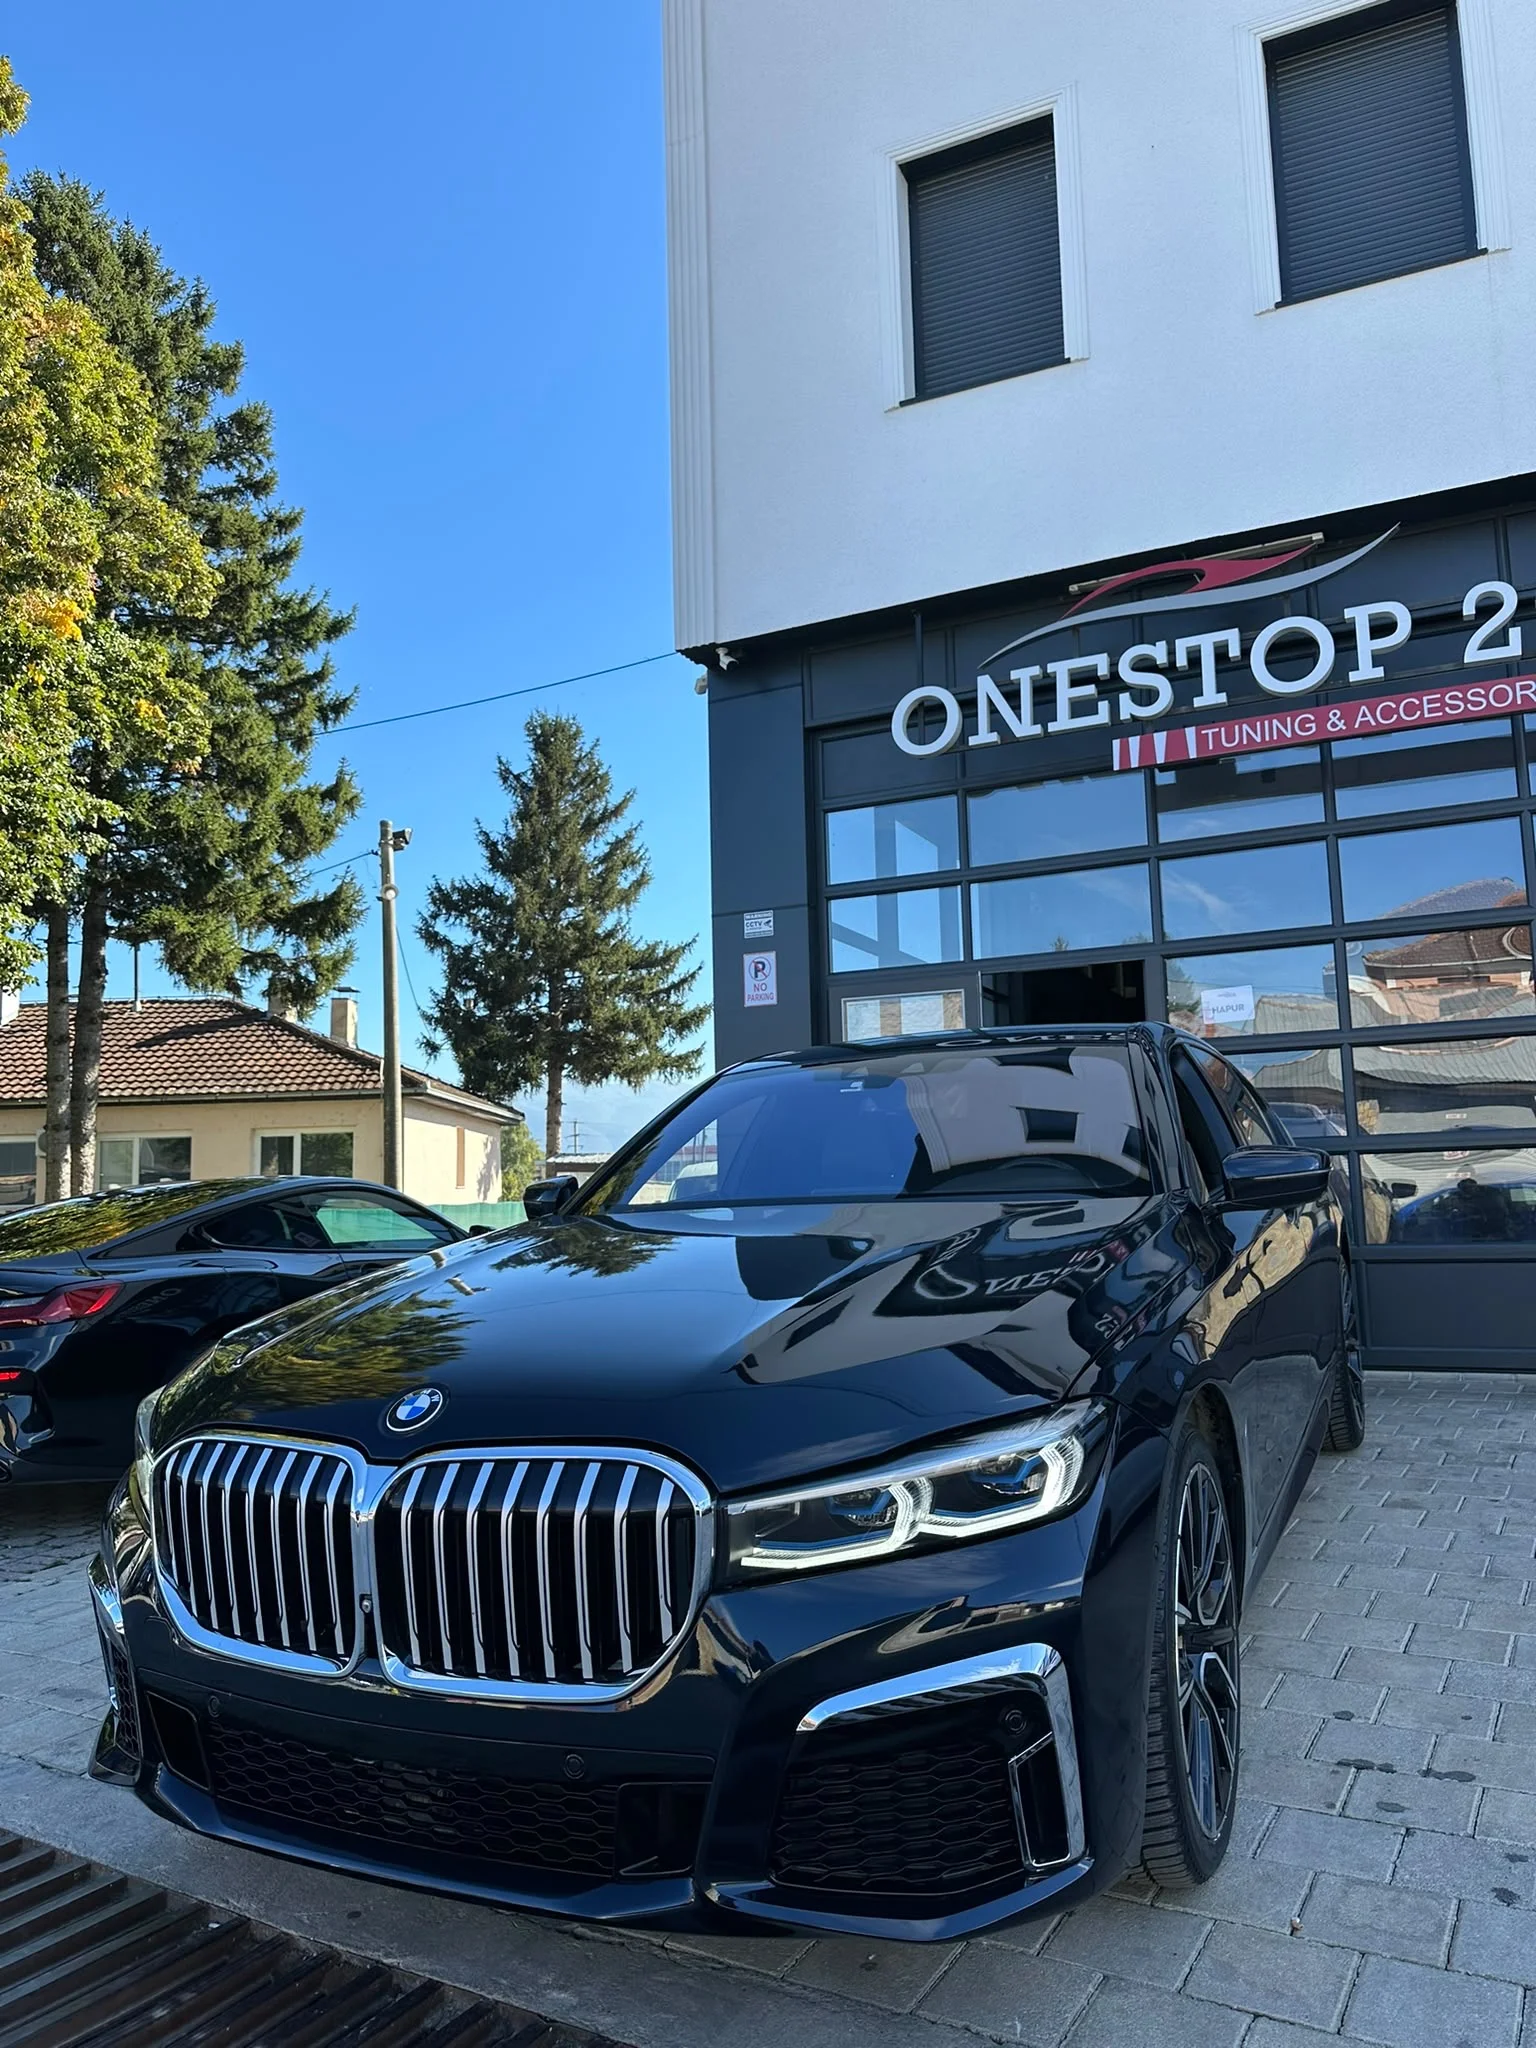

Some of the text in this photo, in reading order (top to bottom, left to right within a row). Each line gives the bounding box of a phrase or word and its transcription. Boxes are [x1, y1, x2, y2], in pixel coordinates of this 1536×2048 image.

[891, 601, 1412, 757] ONESTOP
[1201, 680, 1536, 750] TUNING & ACCESSOR
[747, 992, 774, 1002] PARKING
[754, 982, 767, 992] NO
